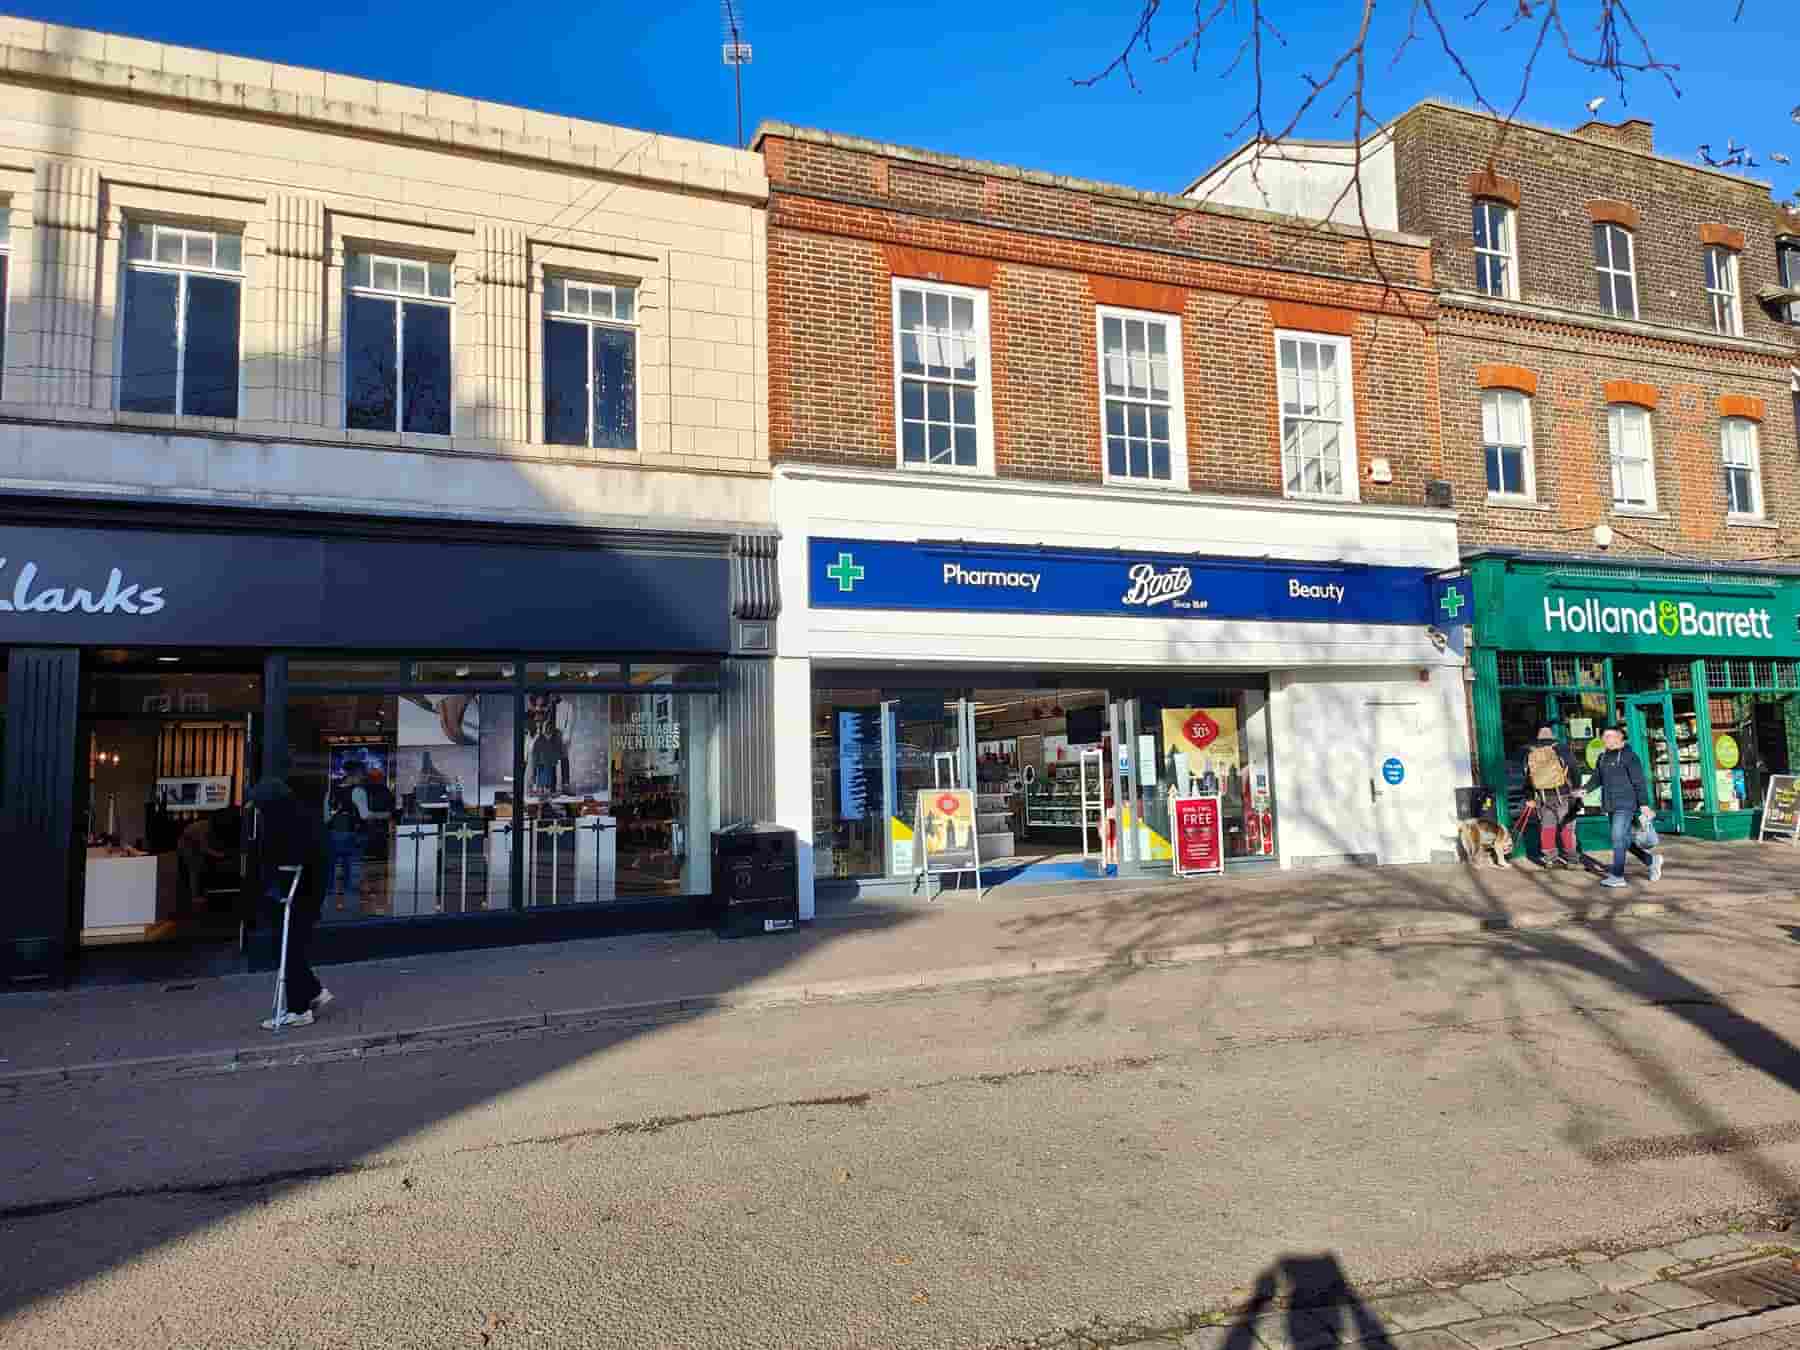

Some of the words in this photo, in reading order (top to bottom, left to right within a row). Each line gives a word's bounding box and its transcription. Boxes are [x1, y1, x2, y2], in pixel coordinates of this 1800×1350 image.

[943, 563, 1041, 592] Pharmacy
[1121, 563, 1193, 606] Boots
[1289, 578, 1345, 603] Beauty
[1543, 596, 1658, 635] Holland
[1679, 602, 1774, 639] Barrett
[1183, 812, 1214, 825] FREE
